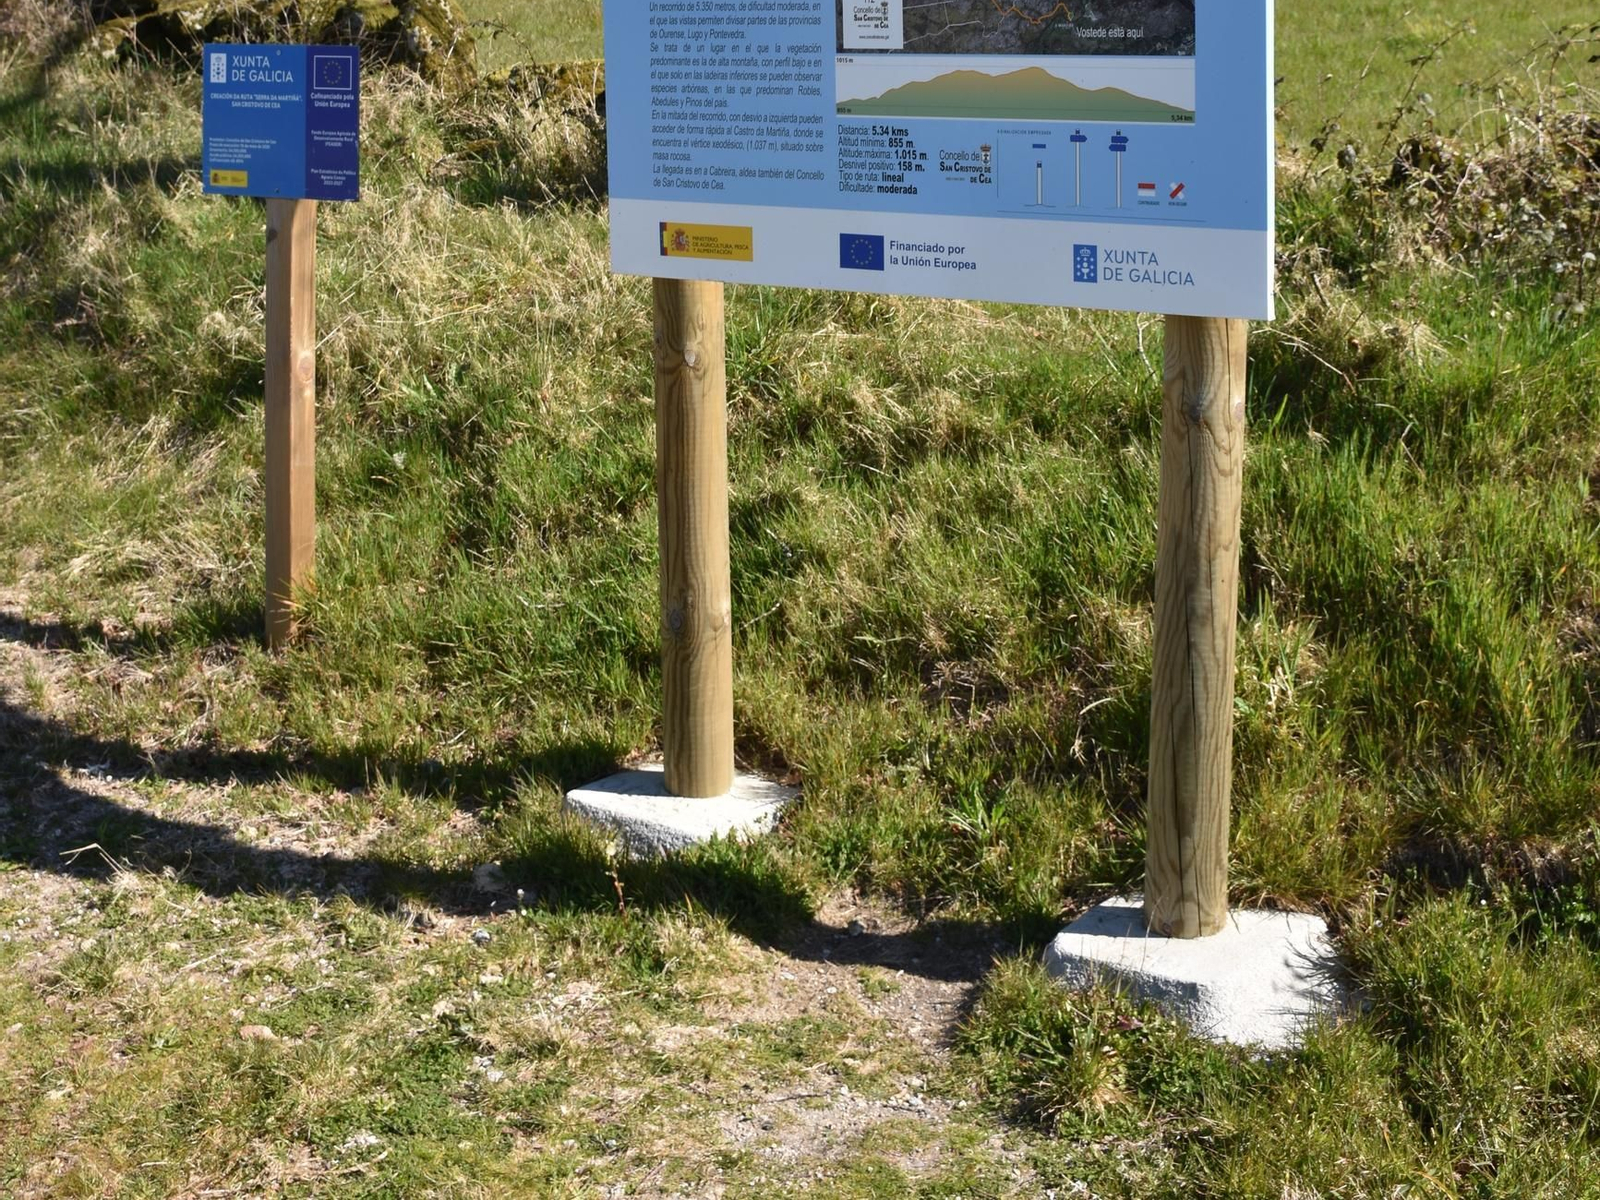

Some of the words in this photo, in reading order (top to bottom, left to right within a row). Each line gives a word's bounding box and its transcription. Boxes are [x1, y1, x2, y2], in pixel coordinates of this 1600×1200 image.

[1076, 27, 1106, 37] Vostede
[1108, 26, 1124, 37] está
[232, 56, 270, 68] XUNTA
[232, 70, 245, 81] DE
[250, 70, 294, 83] GALICIA
[838, 125, 869, 136] Distancia:
[872, 125, 888, 136] 5.34
[891, 126, 908, 136] kms
[838, 136, 858, 147] Altitud
[860, 136, 885, 147] mínima:
[888, 137, 903, 148] 855
[895, 149, 916, 160] 1.015
[939, 150, 969, 160] Concello
[970, 151, 980, 161] de
[838, 159, 866, 170] Desnivel
[868, 160, 894, 173] positivo:
[898, 160, 912, 171] 158
[840, 170, 852, 183] Tipo
[854, 170, 862, 181] de
[865, 171, 879, 181] ruta:
[882, 171, 904, 182] lineal
[839, 181, 877, 193] Dificultade:
[877, 182, 917, 194] moderada
[890, 240, 945, 253] Financiado
[948, 246, 965, 255] por
[890, 255, 898, 265] la
[901, 256, 930, 267] Unión
[934, 258, 976, 271] Europea
[1104, 249, 1158, 266] XUNTA
[1103, 267, 1123, 281] DE
[1129, 268, 1195, 286] GALICIA
